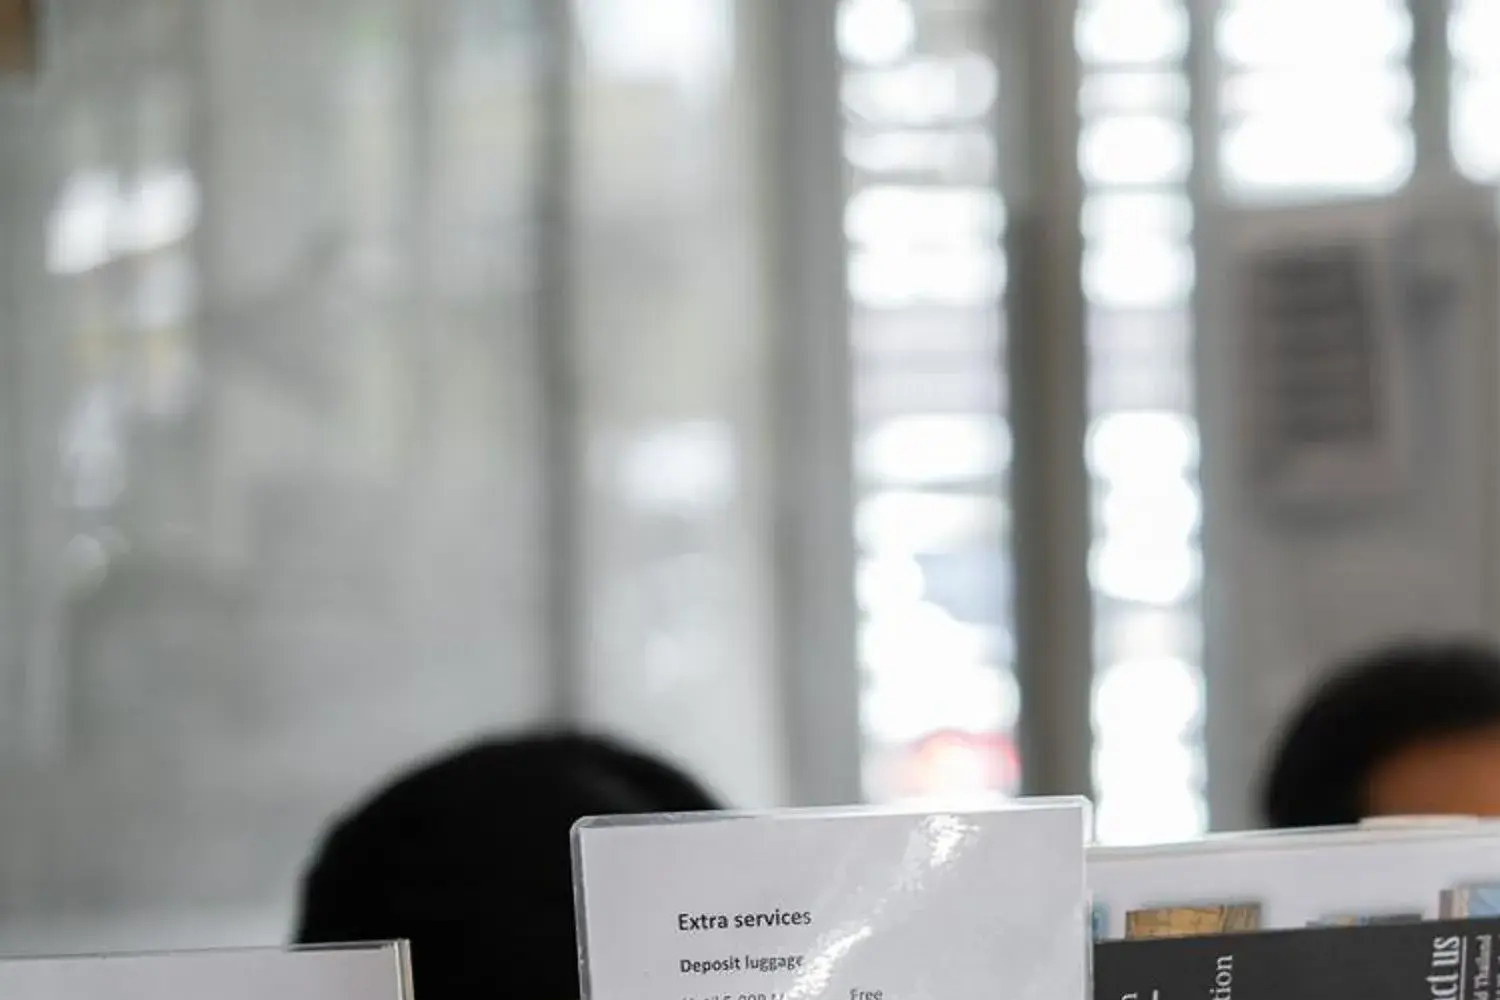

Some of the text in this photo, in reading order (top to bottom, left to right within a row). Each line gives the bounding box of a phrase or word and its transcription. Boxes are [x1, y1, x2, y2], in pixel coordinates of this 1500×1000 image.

[678, 909, 812, 931] Extra services
[1432, 936, 1460, 967] us
[680, 955, 741, 974] Deposit
